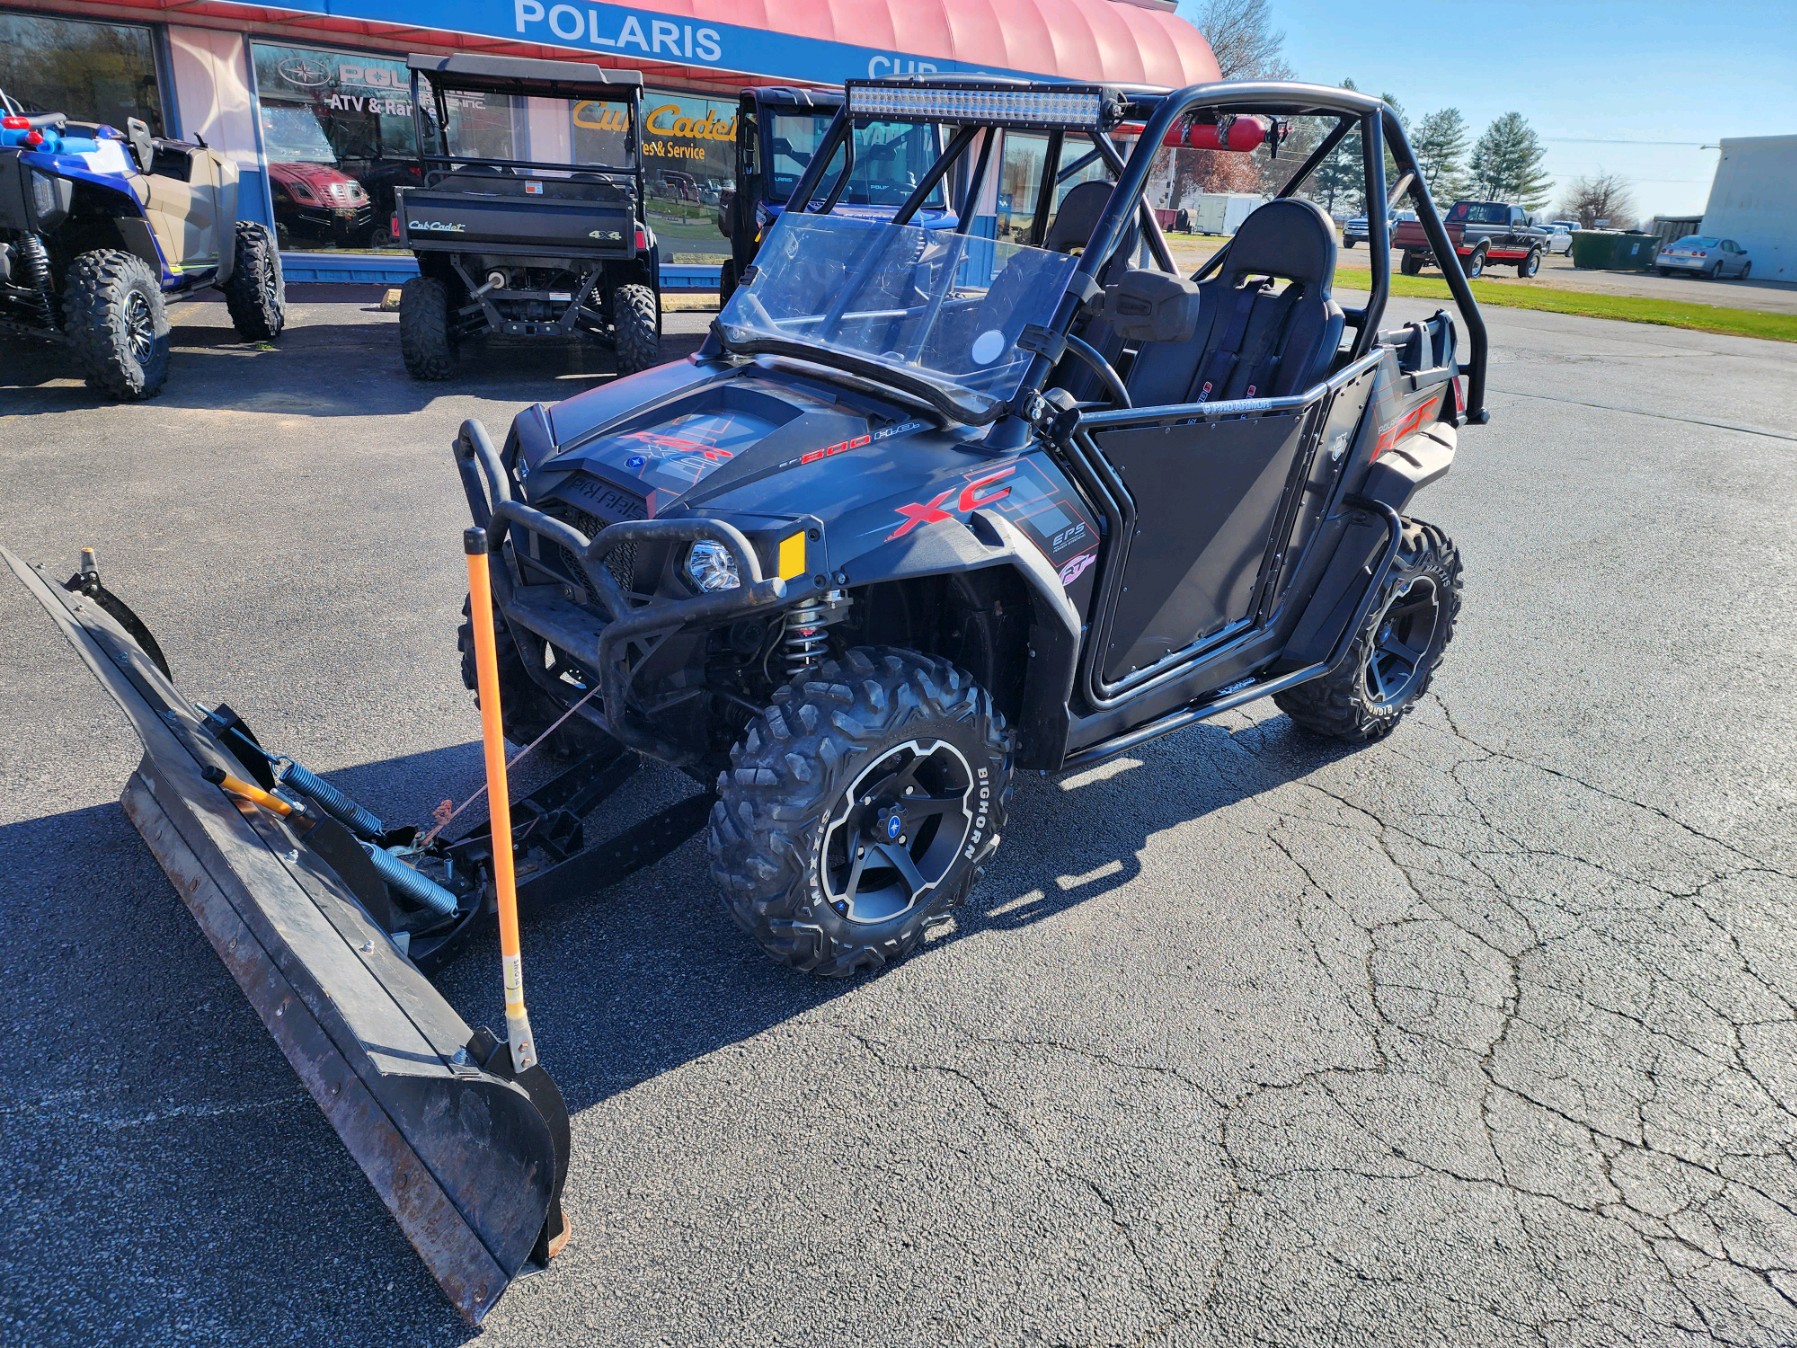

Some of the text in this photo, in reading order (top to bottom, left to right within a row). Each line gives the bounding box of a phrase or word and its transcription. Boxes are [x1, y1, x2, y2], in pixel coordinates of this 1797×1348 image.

[515, 0, 722, 62] POLARIS
[330, 94, 363, 112] ATV
[368, 97, 381, 114] &
[656, 141, 665, 157] &
[667, 142, 705, 160] Service
[408, 220, 466, 233] Cub Cadet
[1234, 399, 1270, 411] ARMOR
[1368, 395, 1438, 465] RZR
[800, 434, 871, 465] 800
[885, 465, 1016, 543] XC
[1053, 521, 1086, 546] EPS
[1423, 563, 1451, 588] MAXXIS
[964, 767, 990, 860] BIGHORN
[807, 808, 832, 907] MAXXIS
